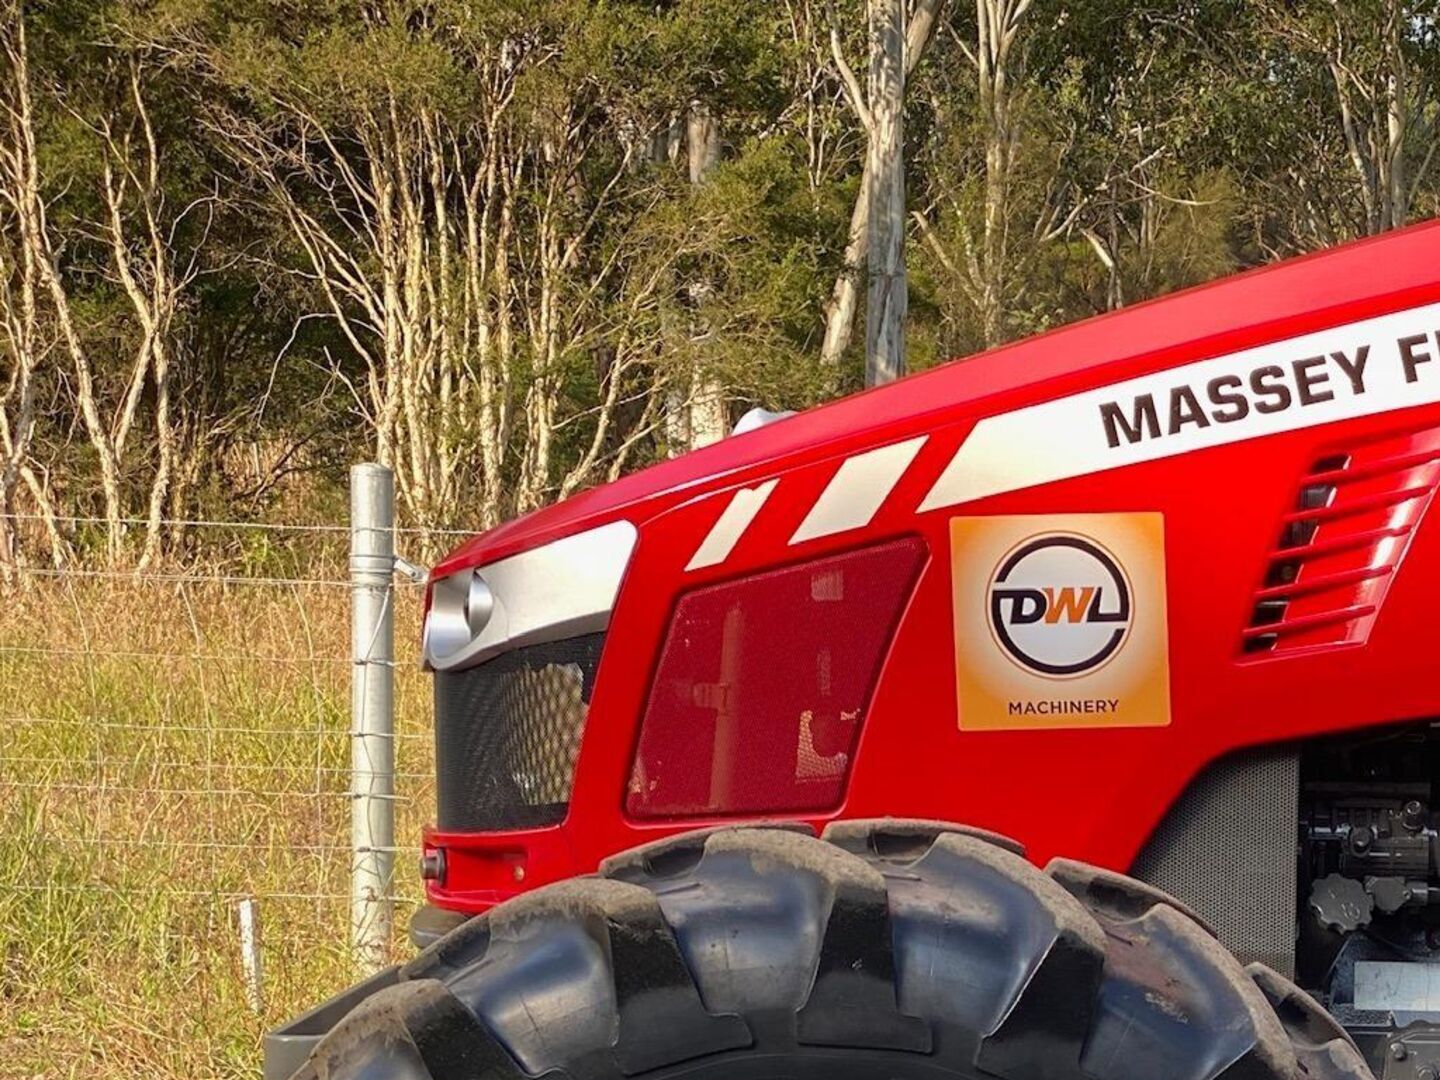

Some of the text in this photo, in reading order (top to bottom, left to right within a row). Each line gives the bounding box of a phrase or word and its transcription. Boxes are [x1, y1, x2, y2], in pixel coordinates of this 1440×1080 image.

[1099, 345, 1372, 449] MASSEY
[992, 586, 1130, 625] DWL
[1008, 699, 1120, 716] MACHINERY
